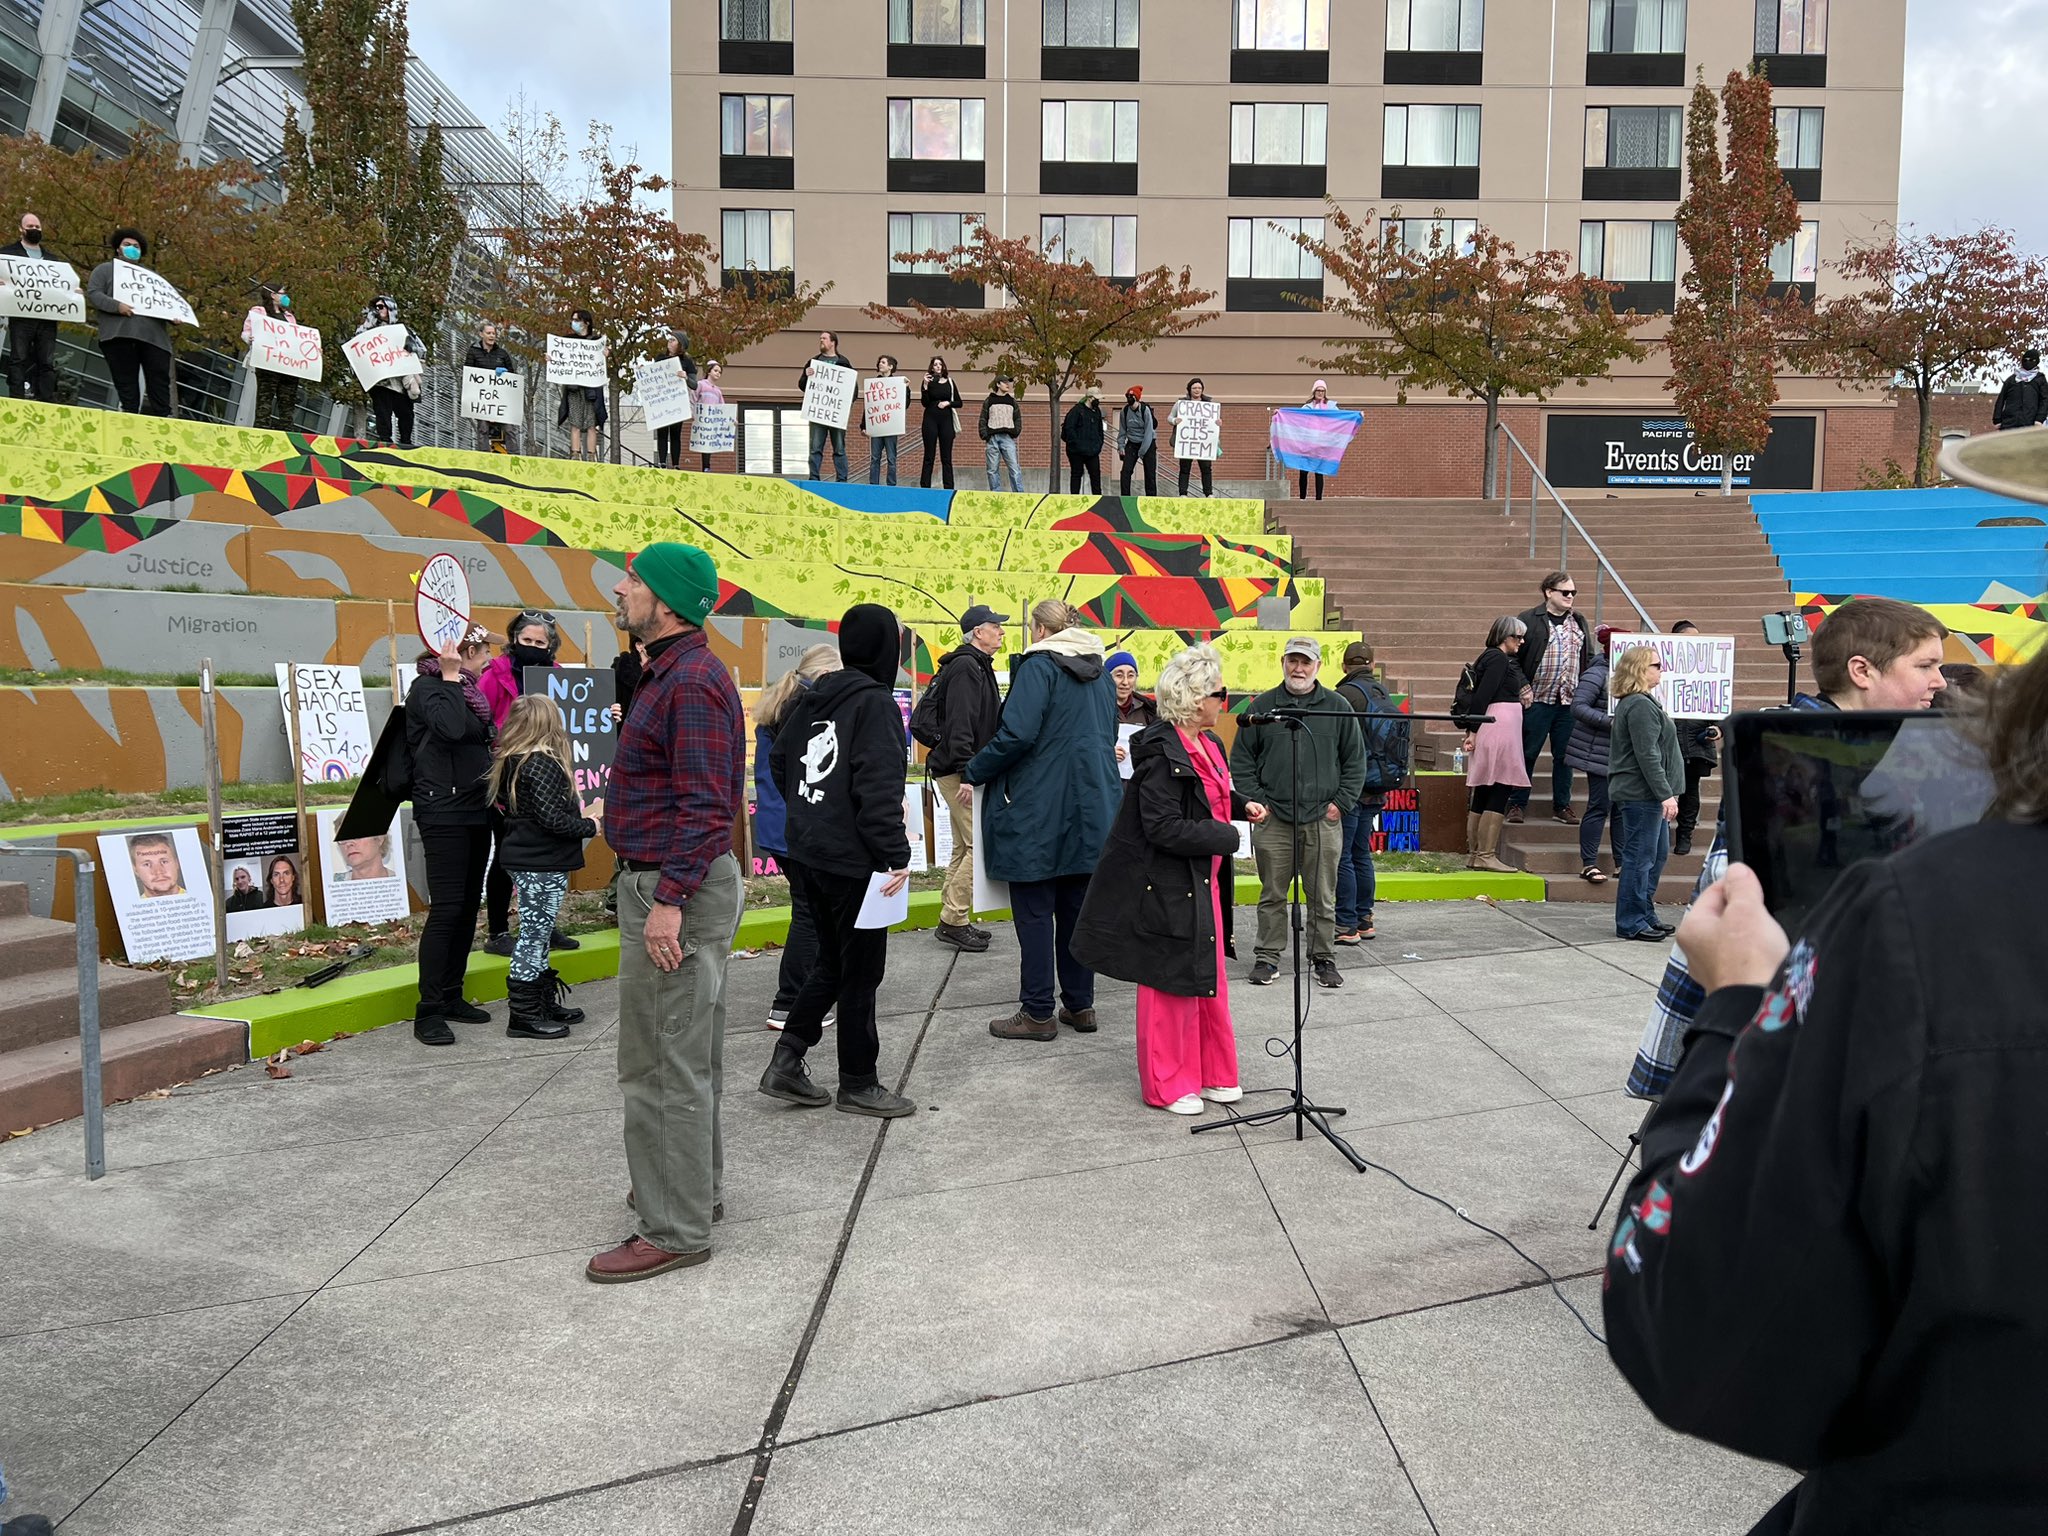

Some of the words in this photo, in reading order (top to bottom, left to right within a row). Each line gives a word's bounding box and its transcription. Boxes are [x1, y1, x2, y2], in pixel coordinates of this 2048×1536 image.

[1, 259, 60, 278] Trans
[11, 276, 70, 290] women
[121, 282, 145, 291] are
[14, 289, 41, 300] are
[131, 293, 173, 309] rights
[275, 337, 290, 348] in
[351, 333, 388, 357] Trans
[554, 338, 578, 352] Stop
[578, 351, 594, 360] the
[815, 365, 846, 384] HATE
[809, 381, 824, 393] HAS
[826, 385, 840, 396] NO
[869, 381, 884, 391] NO
[811, 392, 843, 410] HOME
[865, 387, 897, 403] TERFS
[471, 402, 507, 416] HATE
[808, 407, 840, 423] HERE
[867, 405, 880, 414] ON
[884, 401, 901, 411] OUR
[1178, 402, 1220, 419] CRASH
[869, 413, 891, 426] TURF
[1188, 418, 1208, 427] THE
[1179, 427, 1214, 440] CIS-
[1179, 441, 1212, 458] TEM
[1605, 442, 1679, 471] Events
[1683, 442, 1755, 471] Cener
[126, 553, 213, 577] Justice
[462, 556, 487, 574] ife
[424, 558, 454, 591] WITCH
[168, 615, 257, 634] Migration
[434, 615, 462, 647] TERF
[1675, 642, 1731, 674] ADULT
[297, 669, 343, 689] SEX
[1673, 679, 1730, 714] FEMALE
[315, 712, 338, 735] IS
[1382, 811, 1419, 831] WITH
[1388, 833, 1420, 852] MEN
